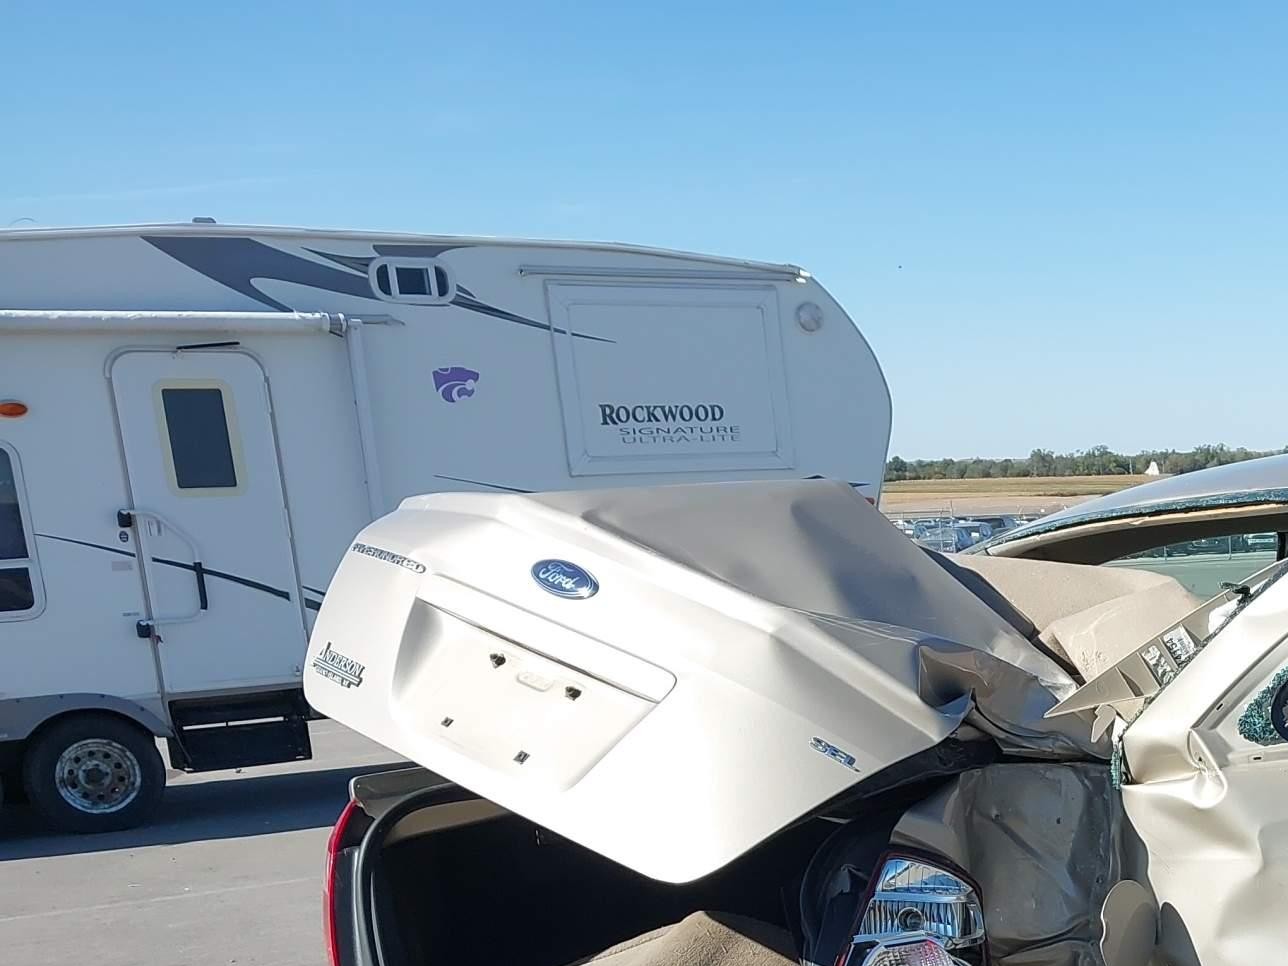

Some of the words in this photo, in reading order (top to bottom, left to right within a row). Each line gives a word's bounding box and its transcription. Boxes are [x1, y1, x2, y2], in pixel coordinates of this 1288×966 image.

[598, 403, 725, 426] ROCKWOOD
[619, 425, 741, 436] SIGNATURE
[621, 435, 741, 444] ULTRA-LITE
[319, 641, 366, 679] ANDERSON
[809, 736, 861, 773] SEL
